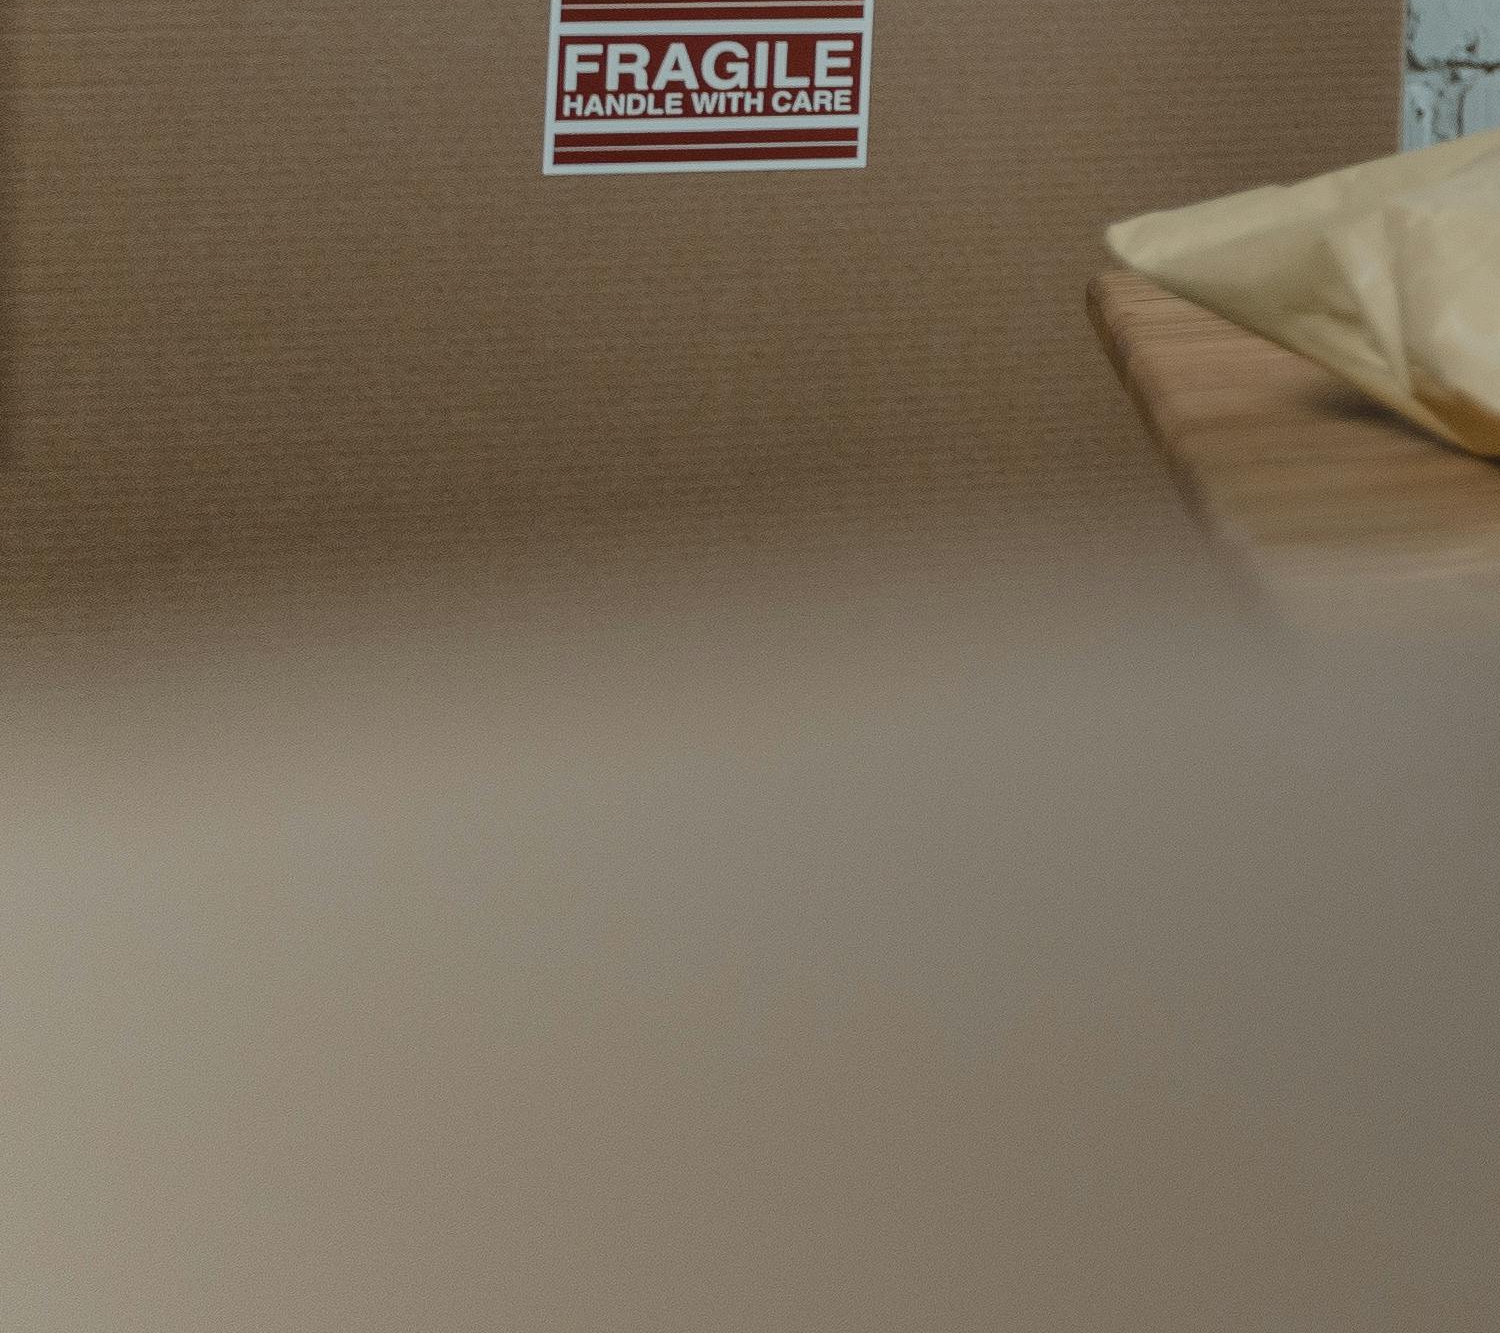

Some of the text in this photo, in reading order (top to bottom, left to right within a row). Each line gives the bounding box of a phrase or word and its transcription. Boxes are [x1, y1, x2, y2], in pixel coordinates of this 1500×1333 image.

[563, 40, 854, 93] FRAGILE
[562, 89, 852, 117] HANDLE WITH CARE
